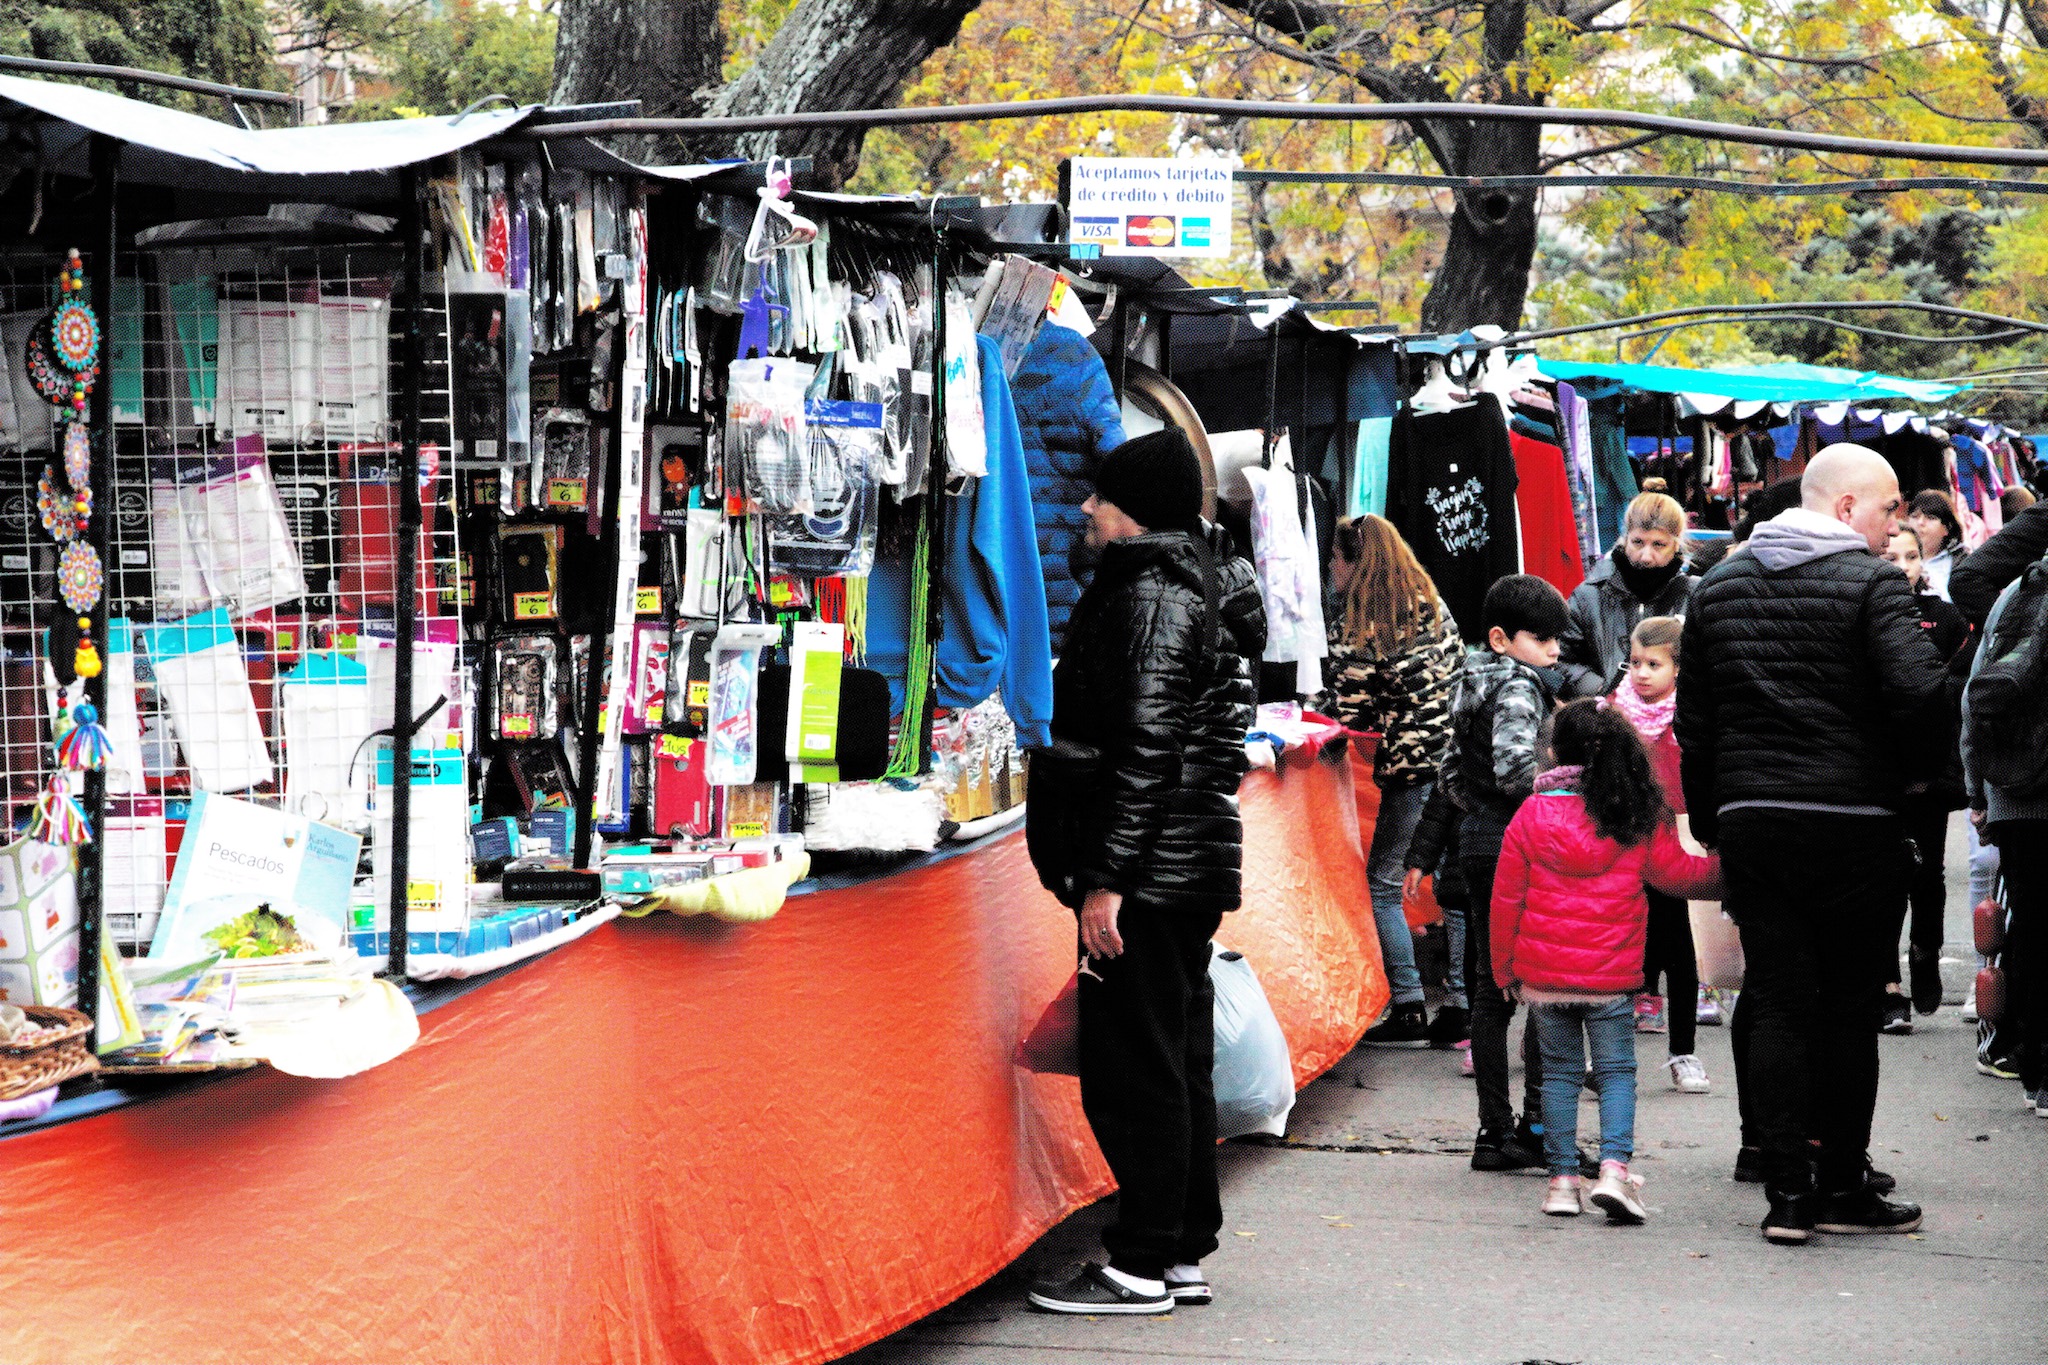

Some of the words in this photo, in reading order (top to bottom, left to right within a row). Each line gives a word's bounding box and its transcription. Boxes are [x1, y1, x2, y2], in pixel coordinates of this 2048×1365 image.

[1076, 165, 1160, 182] Aceptamos
[1167, 166, 1227, 183] tarjetas
[1078, 187, 1096, 201] de
[1082, 226, 1112, 237] VISA
[560, 489, 571, 501] 6
[638, 597, 647, 609] 6
[529, 604, 539, 615] 6
[208, 841, 285, 875] Pescados
